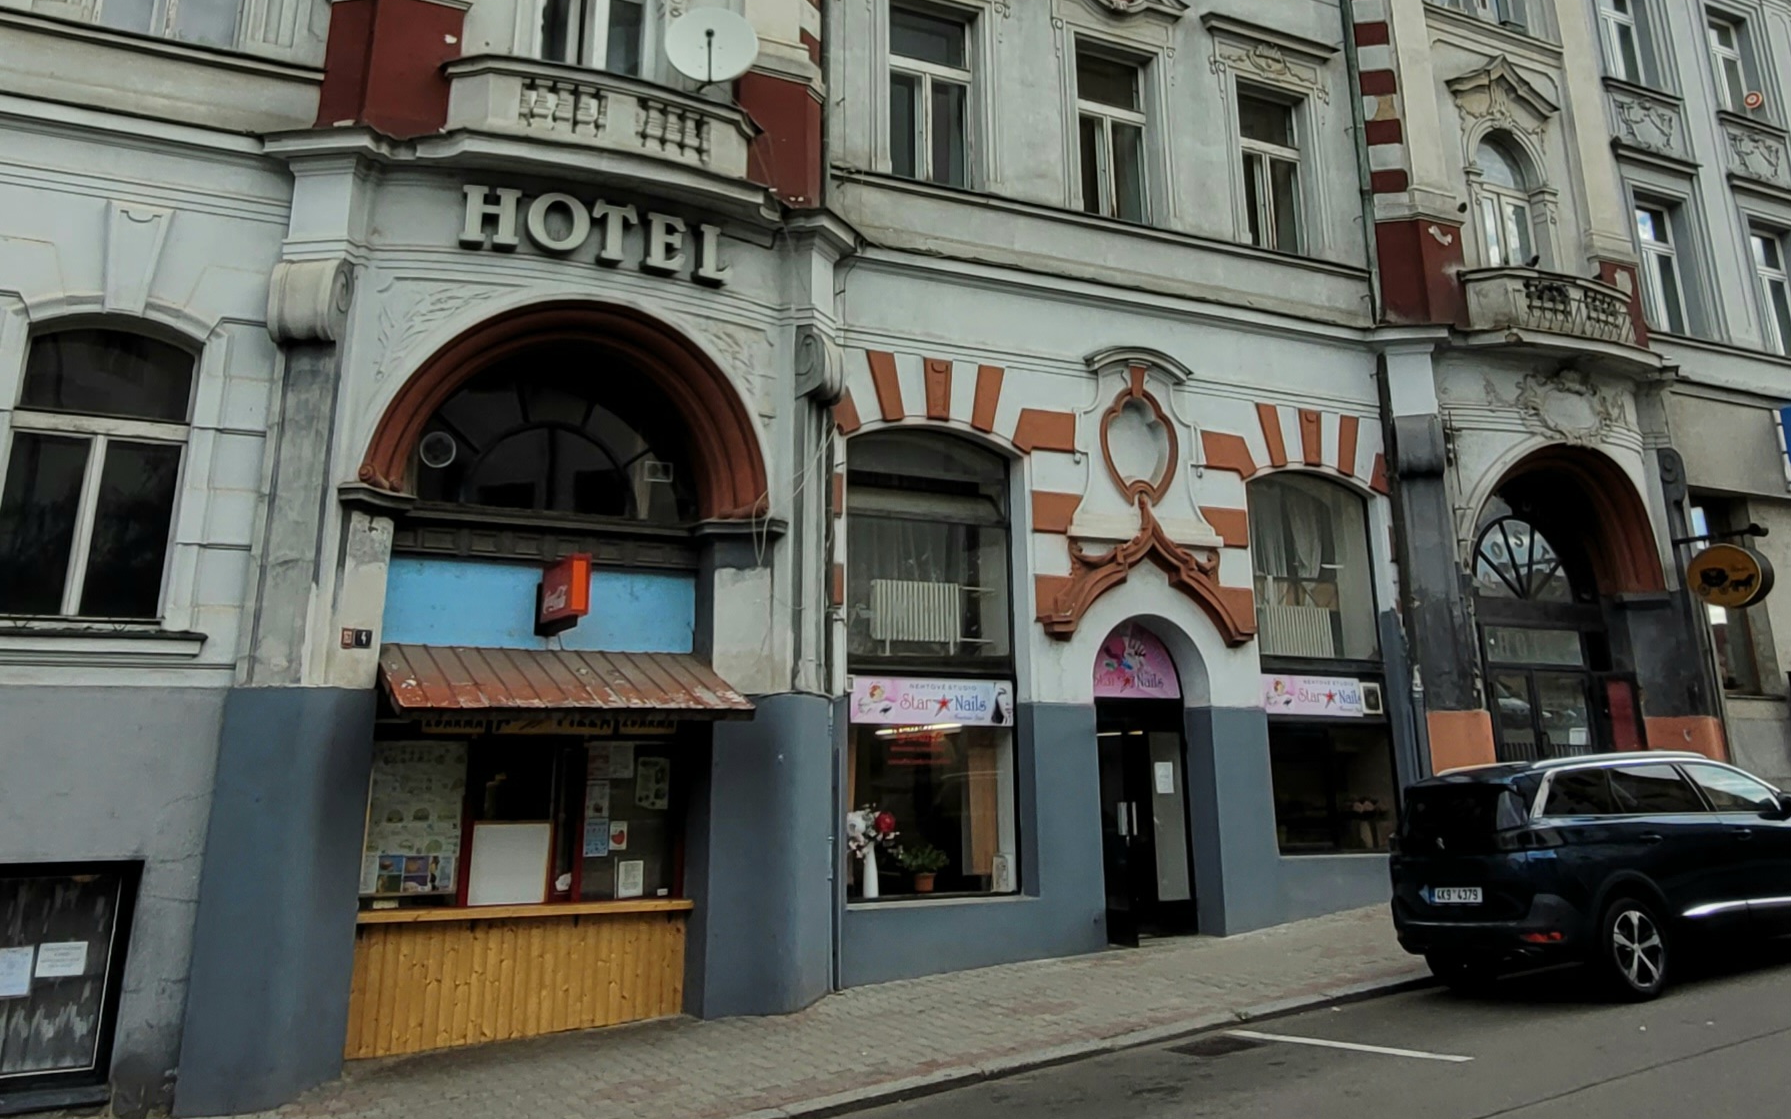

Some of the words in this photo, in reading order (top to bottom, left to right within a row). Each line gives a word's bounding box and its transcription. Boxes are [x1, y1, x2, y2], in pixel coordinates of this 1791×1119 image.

[458, 184, 732, 281] HOTEL
[900, 693, 931, 710] Star
[954, 694, 987, 712] Nails
[1297, 687, 1321, 703] Star
